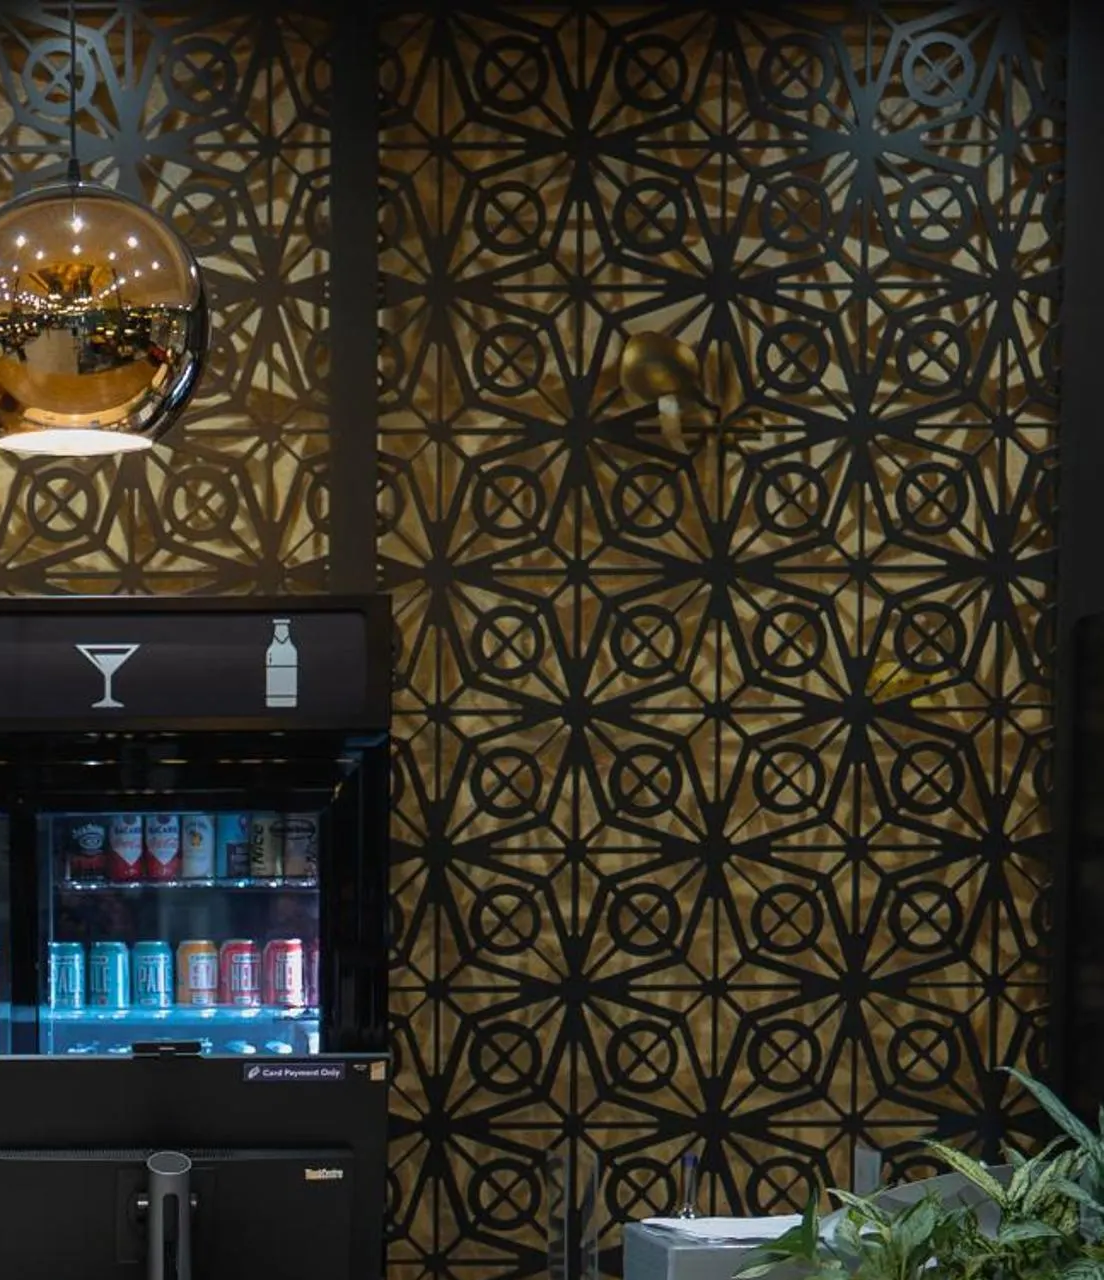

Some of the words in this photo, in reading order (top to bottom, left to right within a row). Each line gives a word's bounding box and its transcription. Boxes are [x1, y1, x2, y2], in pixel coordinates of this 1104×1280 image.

[262, 1068, 283, 1077] Card
[284, 1068, 320, 1080] Payment
[320, 1067, 341, 1079] Only
